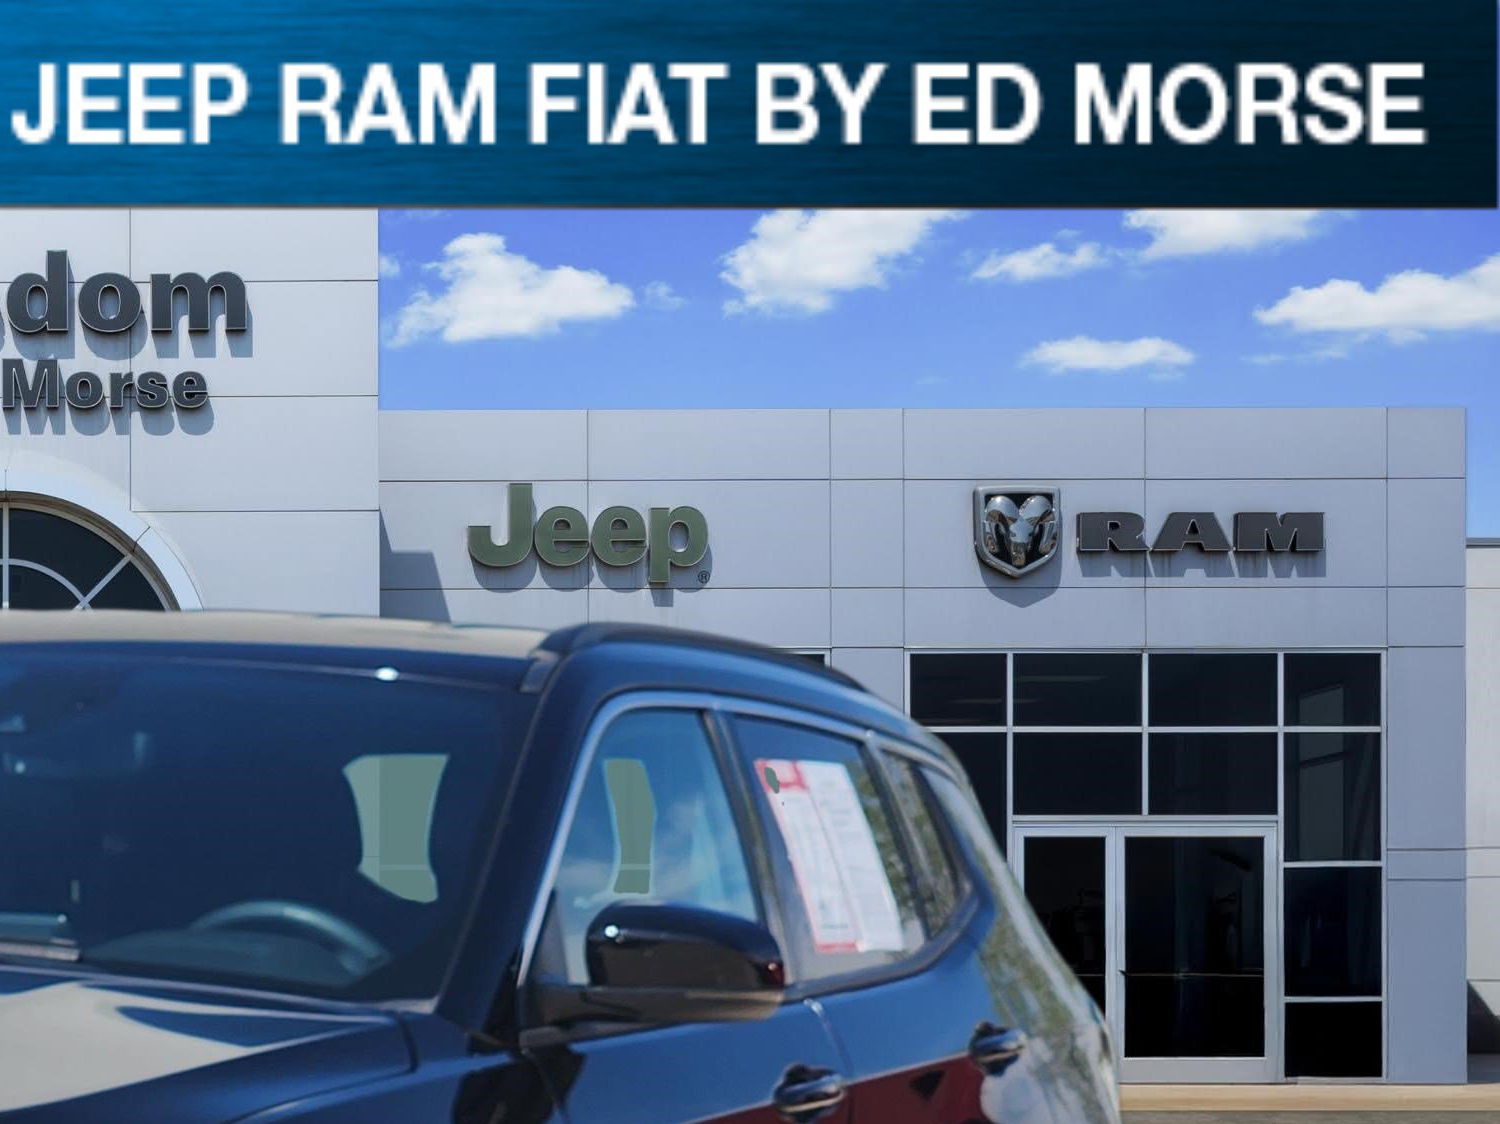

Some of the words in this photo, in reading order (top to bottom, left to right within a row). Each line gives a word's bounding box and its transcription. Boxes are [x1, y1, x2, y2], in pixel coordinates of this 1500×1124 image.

[1, 357, 209, 409] Morse
[467, 482, 709, 583] Jeep
[1075, 511, 1326, 553] RAM
